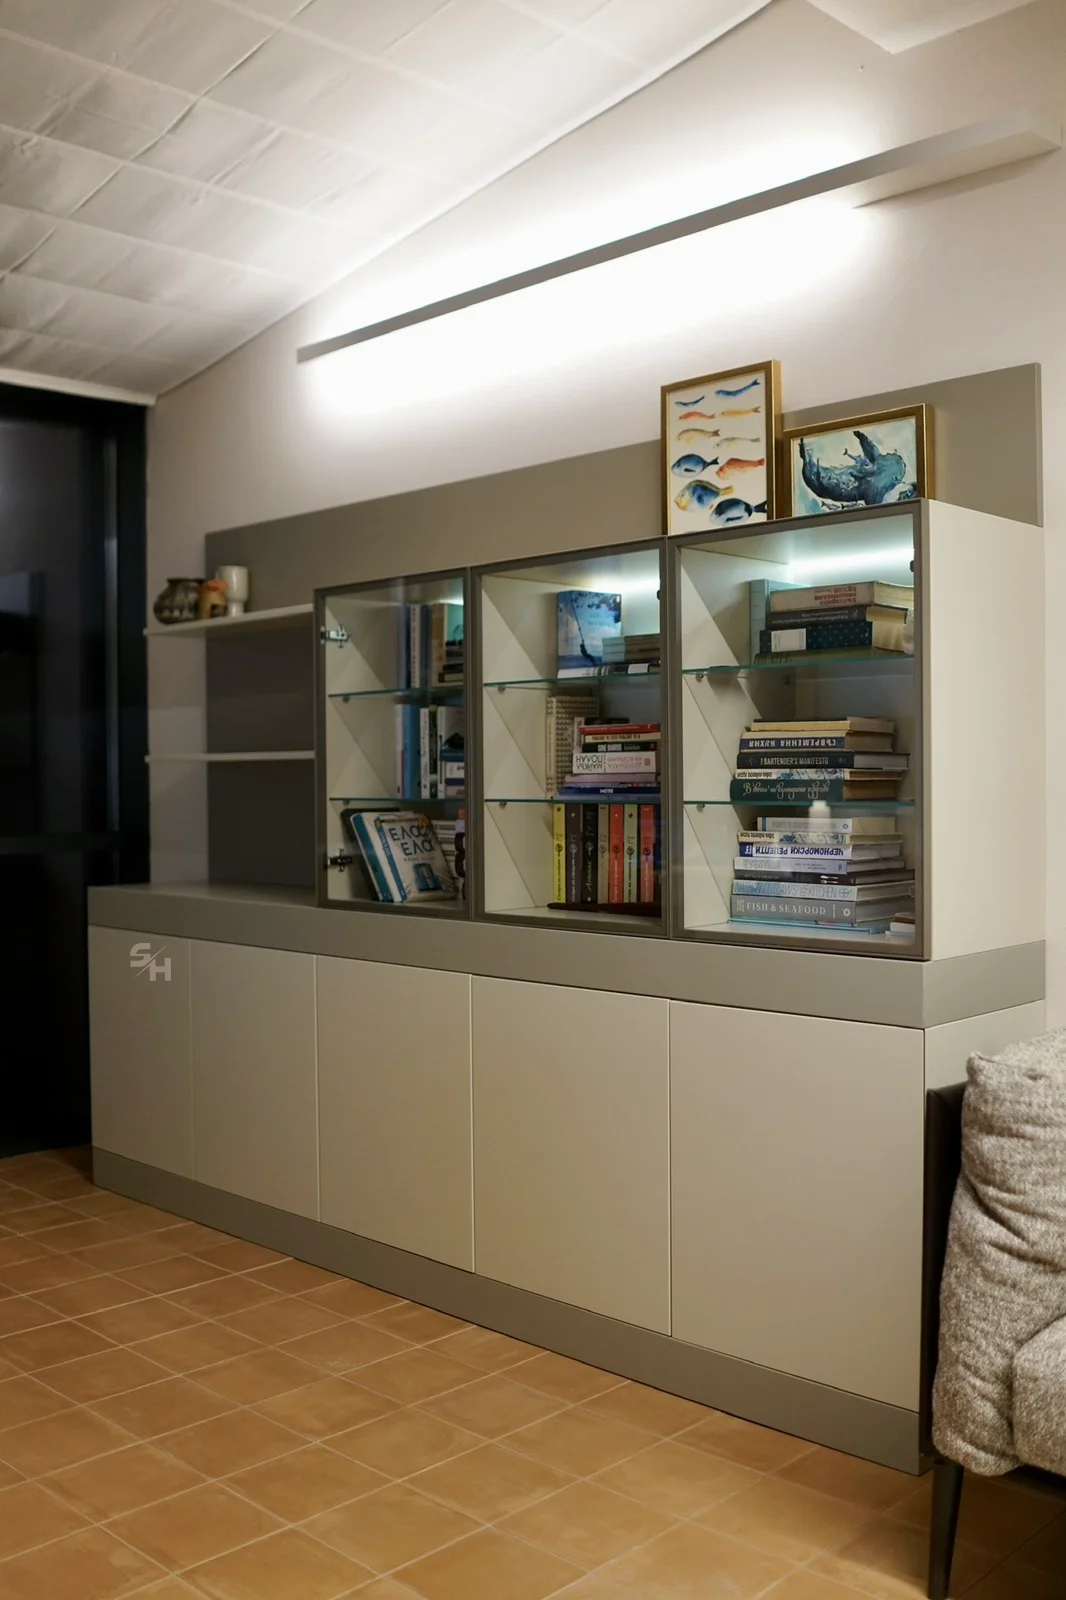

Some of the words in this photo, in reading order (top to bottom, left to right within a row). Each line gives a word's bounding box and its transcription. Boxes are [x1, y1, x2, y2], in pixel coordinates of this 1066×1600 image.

[749, 739, 776, 748] КУХНЯ
[780, 739, 837, 748] СЪВРЕМЕННА
[576, 754, 603, 763] ПОЛАН
[764, 757, 799, 766] BARTENDER'S
[799, 756, 829, 766] MANIFESTO
[755, 846, 788, 856] РЕЦЕПТИ
[790, 846, 844, 856] ЧЕРНОМОРСКИ
[746, 902, 768, 912] FISH
[770, 903, 777, 912] &
[778, 904, 826, 915] SEAFOOD
